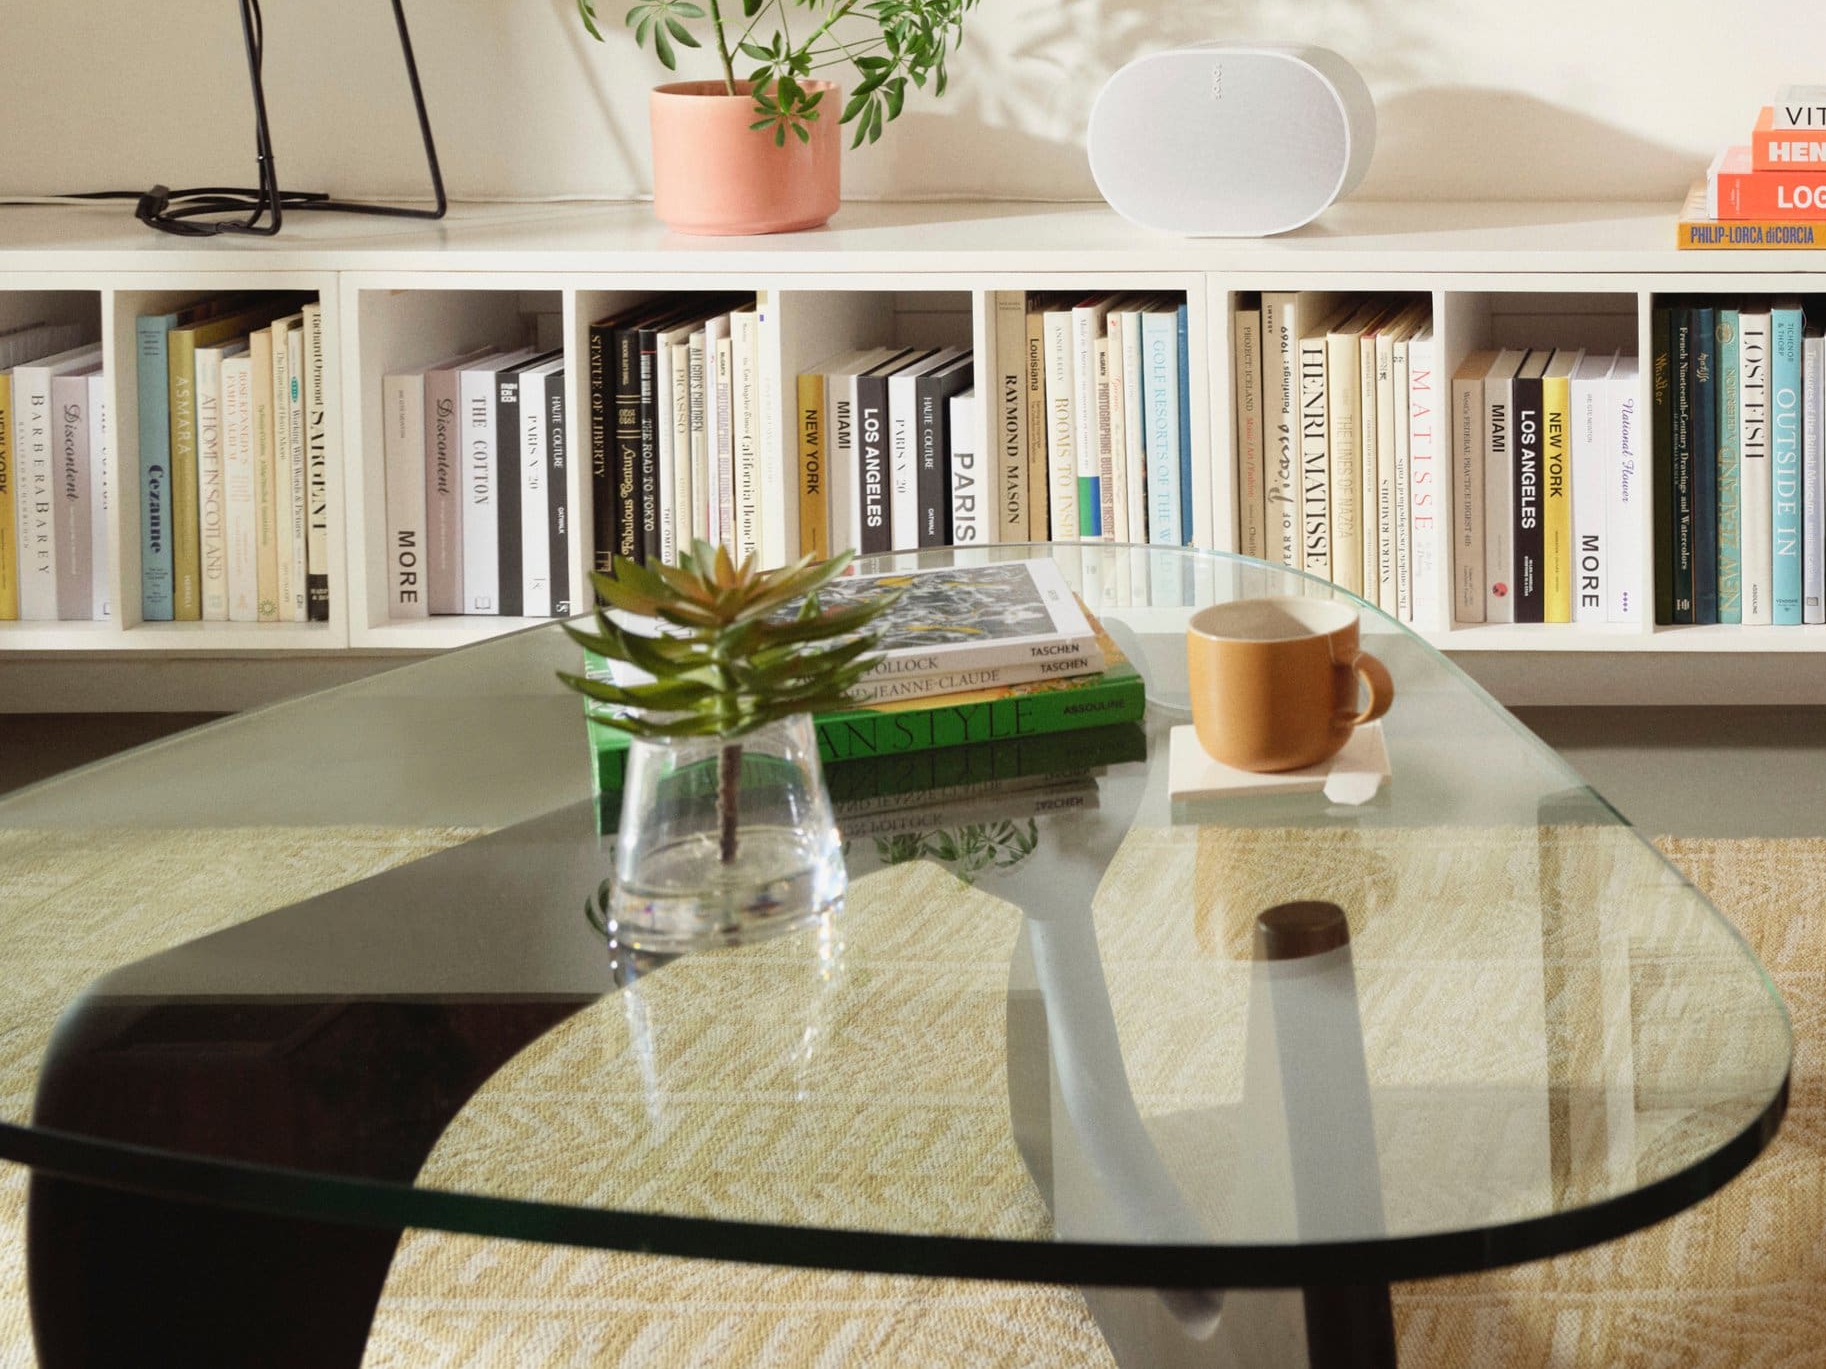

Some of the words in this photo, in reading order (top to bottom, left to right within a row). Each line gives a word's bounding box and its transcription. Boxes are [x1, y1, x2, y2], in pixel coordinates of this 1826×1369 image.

[1690, 226, 1764, 244] PHILIP-LORCA
[1766, 226, 1815, 244] diCORCIA
[591, 334, 603, 390] STATUE
[1153, 339, 1166, 383] GOLF
[1280, 326, 1289, 353] 1969
[1679, 326, 1689, 361] French
[1744, 331, 1765, 395] LOST
[1029, 338, 1040, 392] Louisiana
[1282, 360, 1290, 413] Paintings:
[1655, 351, 1668, 406] Whistler
[1807, 350, 1817, 404] Treasures
[200, 392, 218, 412] AT
[472, 396, 487, 428] THE
[551, 396, 563, 425] HAUTE
[593, 392, 604, 412] OF
[676, 369, 686, 434] PICASSO
[923, 397, 932, 424] HAUTE
[1245, 370, 1253, 412] ICELAND
[1303, 349, 1324, 439] HENRI
[1680, 362, 1689, 450] Nineteenth-Century
[175, 376, 191, 455] ASMARA
[202, 413, 219, 466] HOME
[641, 418, 653, 442] THE
[805, 409, 818, 446] NEW
[837, 401, 851, 449] MIAMI
[864, 408, 880, 443] LOS
[1005, 374, 1020, 457] RAYMOND
[1054, 397, 1071, 457] ROOMS
[1098, 382, 1110, 454] PHOTOGRAPHING
[1154, 389, 1169, 461] RESORTS
[1336, 415, 1353, 439] THE
[1492, 404, 1505, 453] MIAMI
[1521, 410, 1536, 444] LOS
[1550, 412, 1562, 448] NEW
[1622, 398, 1634, 458] National
[1744, 403, 1765, 458] FISH
[63, 403, 82, 502] Discontent
[436, 398, 454, 496] Discontent
[552, 427, 563, 469] COUTURE
[593, 415, 605, 478] LIBERTY
[642, 443, 654, 474] ROAD
[741, 435, 755, 502] California
[924, 429, 934, 470] COUTURE
[1267, 424, 1294, 503] Picasso
[1337, 442, 1353, 474] LINES
[1413, 369, 1433, 530] MATISSE
[1776, 388, 1797, 517] OUTSIDE
[203, 469, 218, 485] IN
[311, 411, 327, 532] SARGENT
[472, 440, 489, 505] COTTON
[619, 444, 637, 498] Century
[643, 476, 654, 492] TO
[806, 450, 819, 495] YORK
[865, 447, 882, 527] ANGELES
[1007, 465, 1021, 525] MASON
[1057, 462, 1072, 488] TO
[1101, 457, 1113, 505] BUILDINGS
[1158, 465, 1169, 486] OF
[1338, 477, 1353, 496] OF
[1464, 457, 1472, 500] PRACTICE
[1521, 448, 1536, 529] ANGELES
[1550, 453, 1562, 498] YORK
[1622, 460, 1635, 503] Flower
[1680, 452, 1689, 495] Drawings
[148, 464, 164, 555] Cezanne
[643, 495, 655, 532] TOKYO
[954, 453, 976, 542] PARIS
[1103, 506, 1114, 536] INSIDE
[1159, 492, 1171, 523] THE
[1283, 512, 1292, 528] OF
[1304, 451, 1328, 568] MATISSE
[1464, 502, 1472, 533] DIGEST
[1681, 496, 1689, 514] and
[1718, 445, 1738, 550] ZEALAND
[204, 489, 224, 581] SCOTLAND
[621, 499, 635, 556] Fabulous
[743, 505, 756, 539] Home
[1681, 515, 1690, 570] Watercolors
[1777, 527, 1797, 557] IN
[398, 531, 418, 603] MORE
[1582, 535, 1599, 608] MORE
[1719, 557, 1738, 612] NEW
[866, 656, 939, 676] OLLOCK
[1030, 643, 1080, 657] TASCHEN
[1040, 659, 1088, 674] TASCHEN
[874, 669, 1001, 700] JEANNE-CLAUDE
[1063, 699, 1125, 715] ASSOULINE
[893, 700, 1035, 749] STYLE
